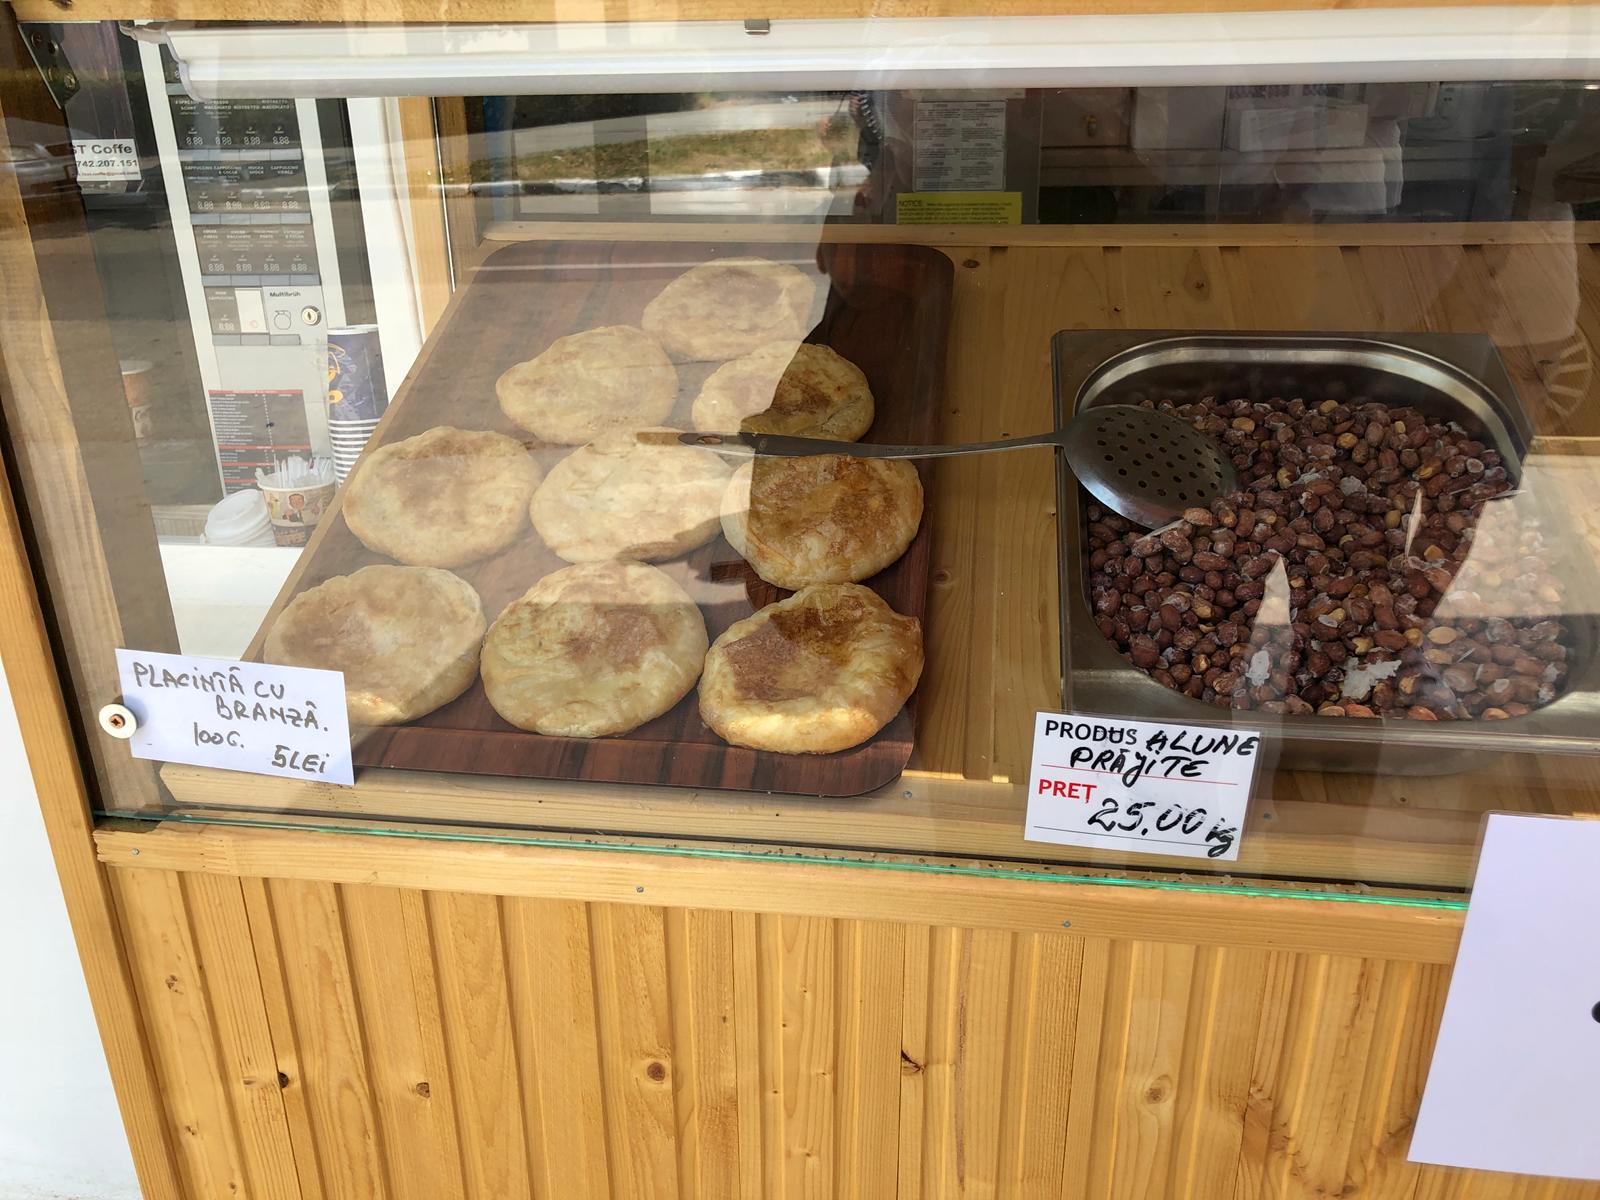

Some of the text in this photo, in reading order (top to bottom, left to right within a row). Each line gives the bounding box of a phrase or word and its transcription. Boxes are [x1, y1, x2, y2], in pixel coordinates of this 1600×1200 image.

[91, 143, 132, 154] Coffe
[254, 680, 285, 699] CU
[1044, 719, 1260, 756] PRODUS ALUNE
